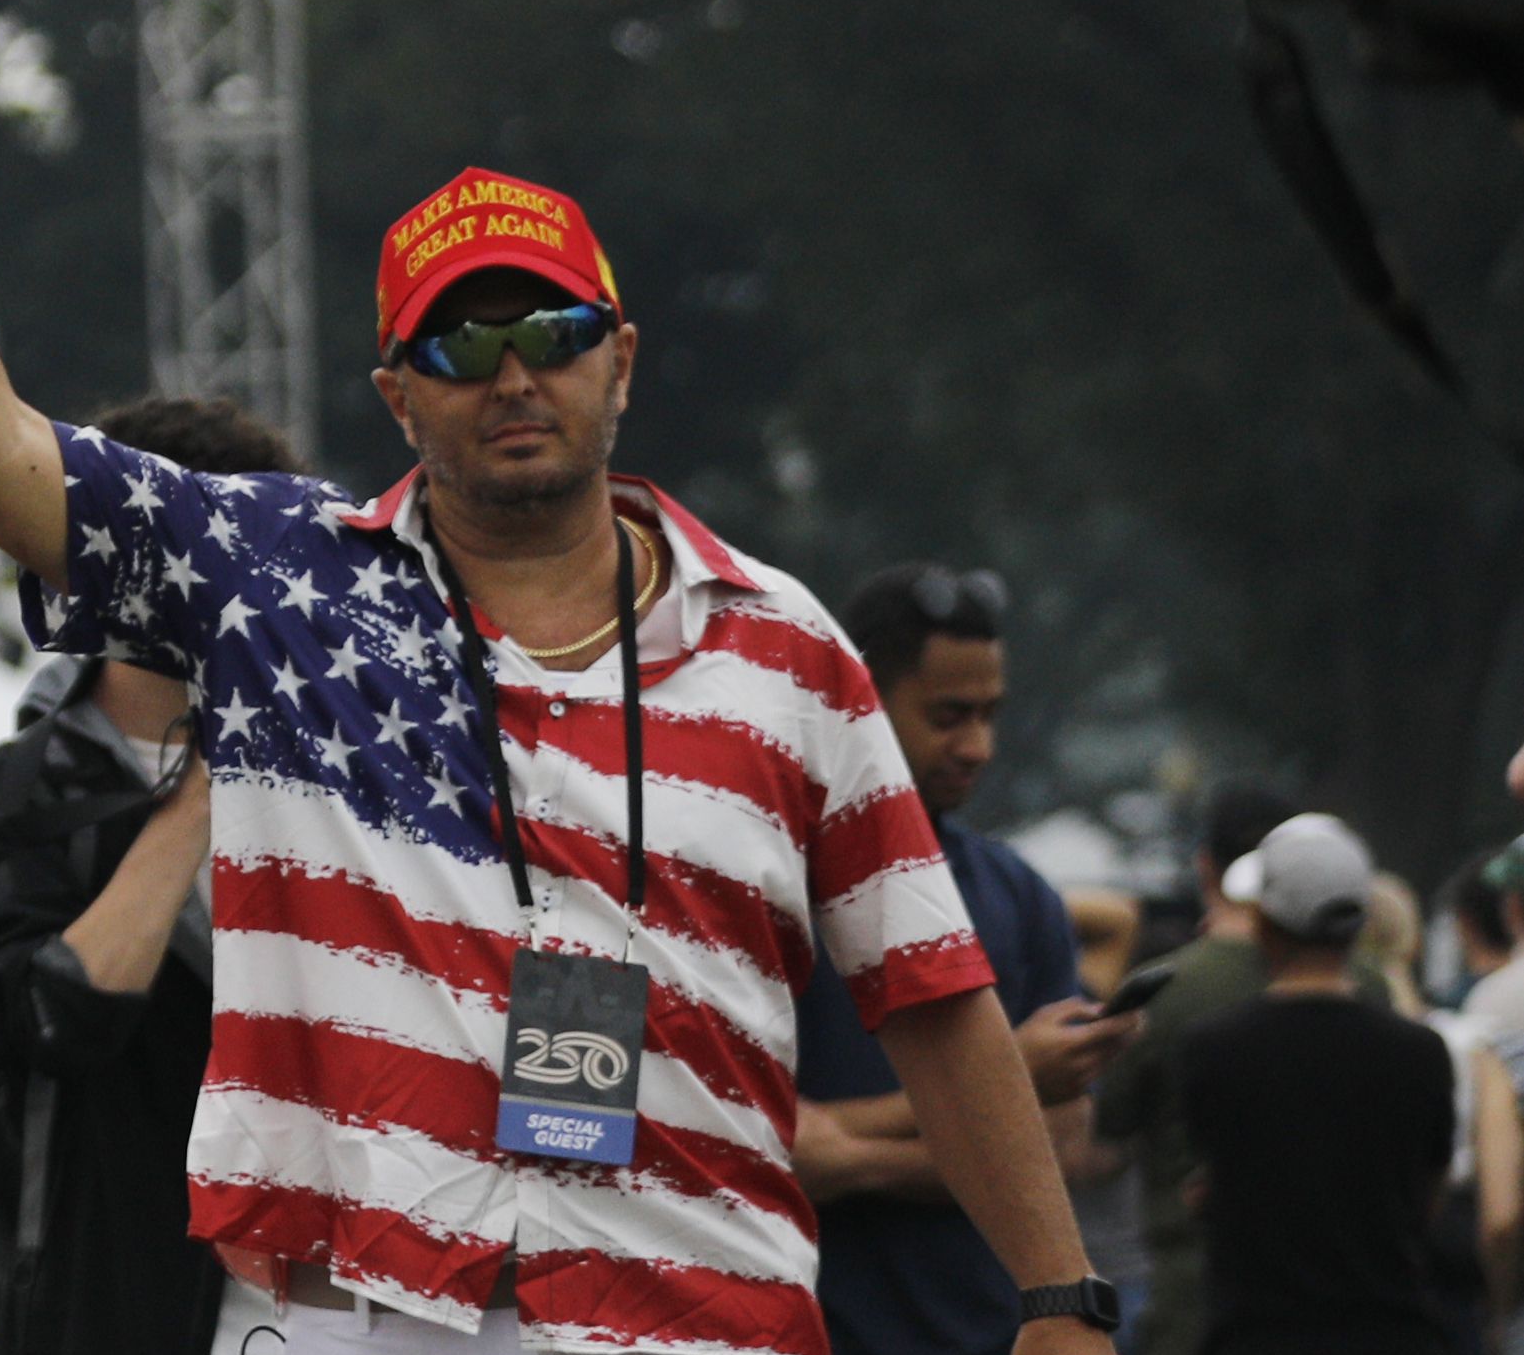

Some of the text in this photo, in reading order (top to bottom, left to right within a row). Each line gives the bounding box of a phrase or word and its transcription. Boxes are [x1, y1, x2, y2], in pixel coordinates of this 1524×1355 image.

[392, 180, 571, 257] MAKE AMERICA
[406, 213, 564, 277] GREAT AGAIN
[513, 1027, 629, 1090] 250
[525, 1113, 605, 1138] SPECIAL
[533, 1130, 598, 1152] GUEST
